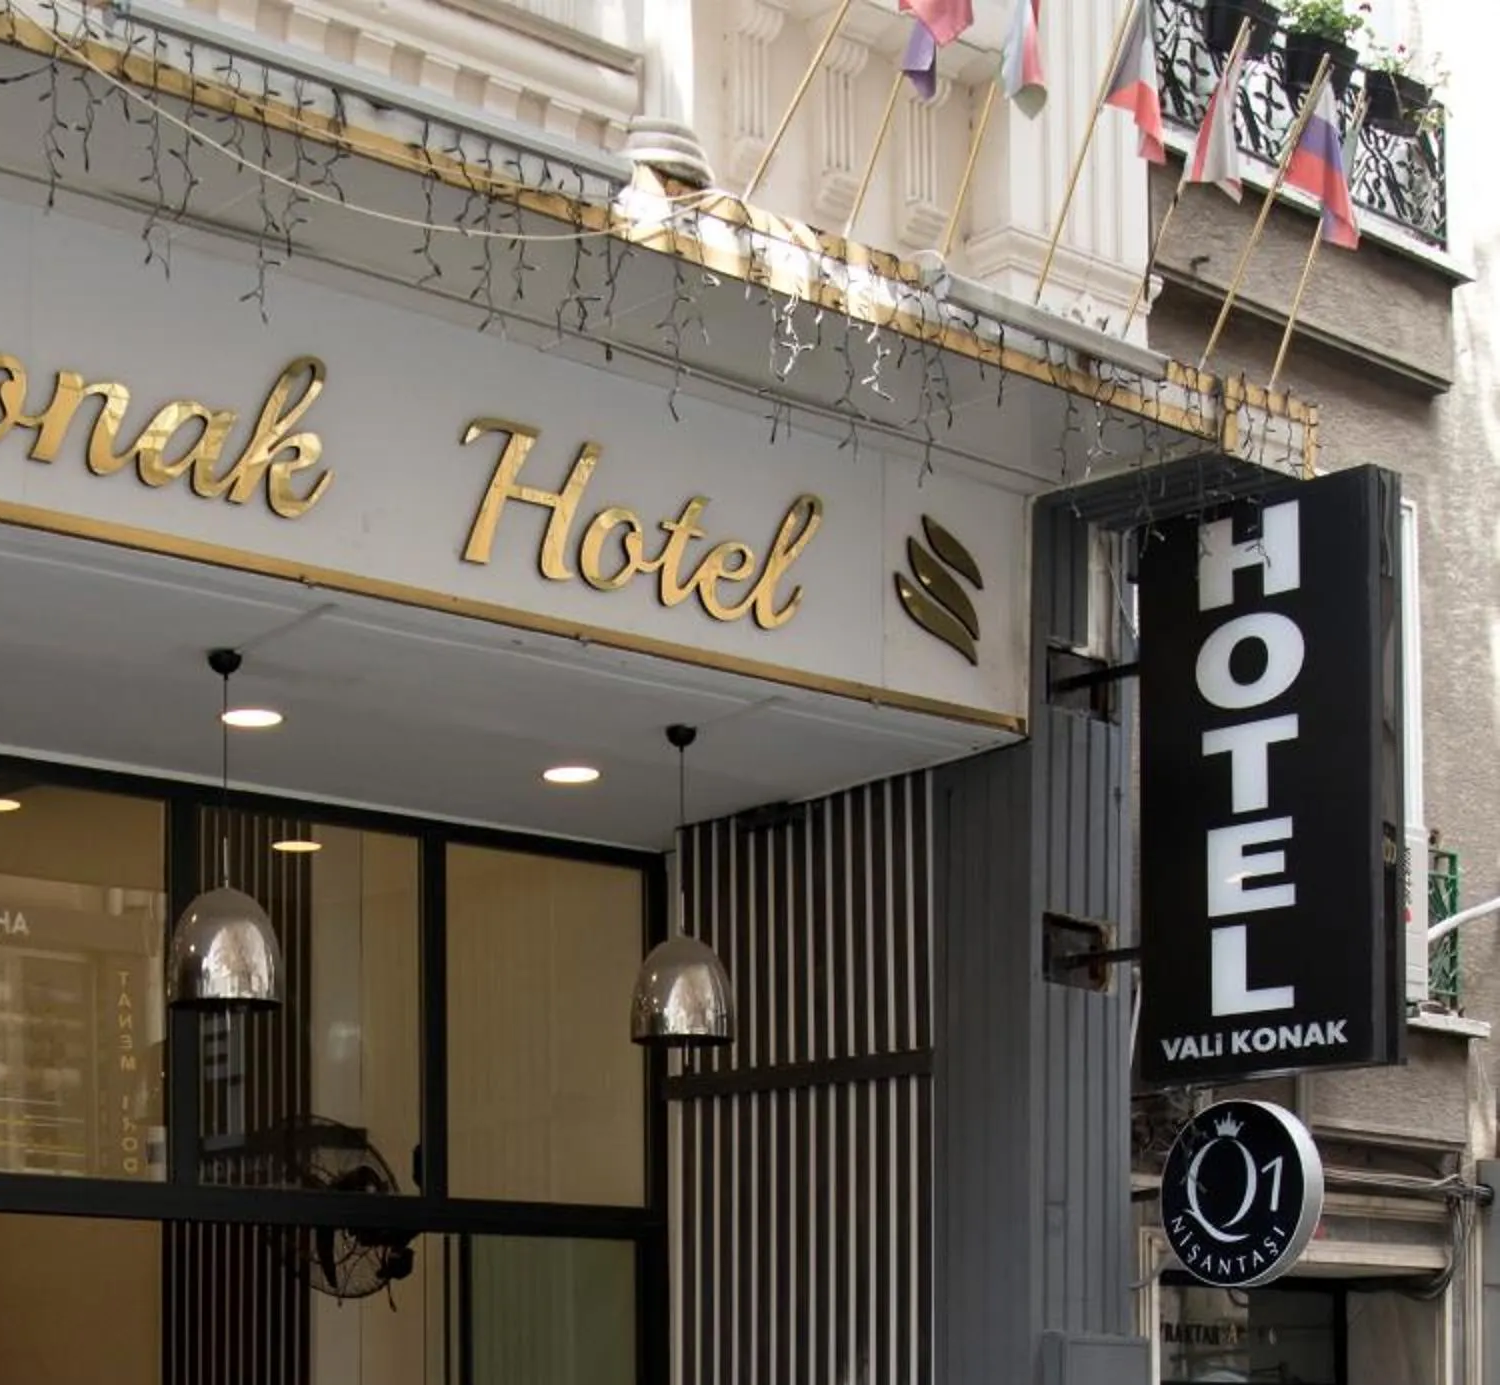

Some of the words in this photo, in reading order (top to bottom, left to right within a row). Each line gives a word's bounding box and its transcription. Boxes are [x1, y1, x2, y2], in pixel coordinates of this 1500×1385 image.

[460, 416, 824, 631] Hotel
[1195, 499, 1305, 1017] HOTEL
[1232, 1019, 1349, 1055] KONAK
